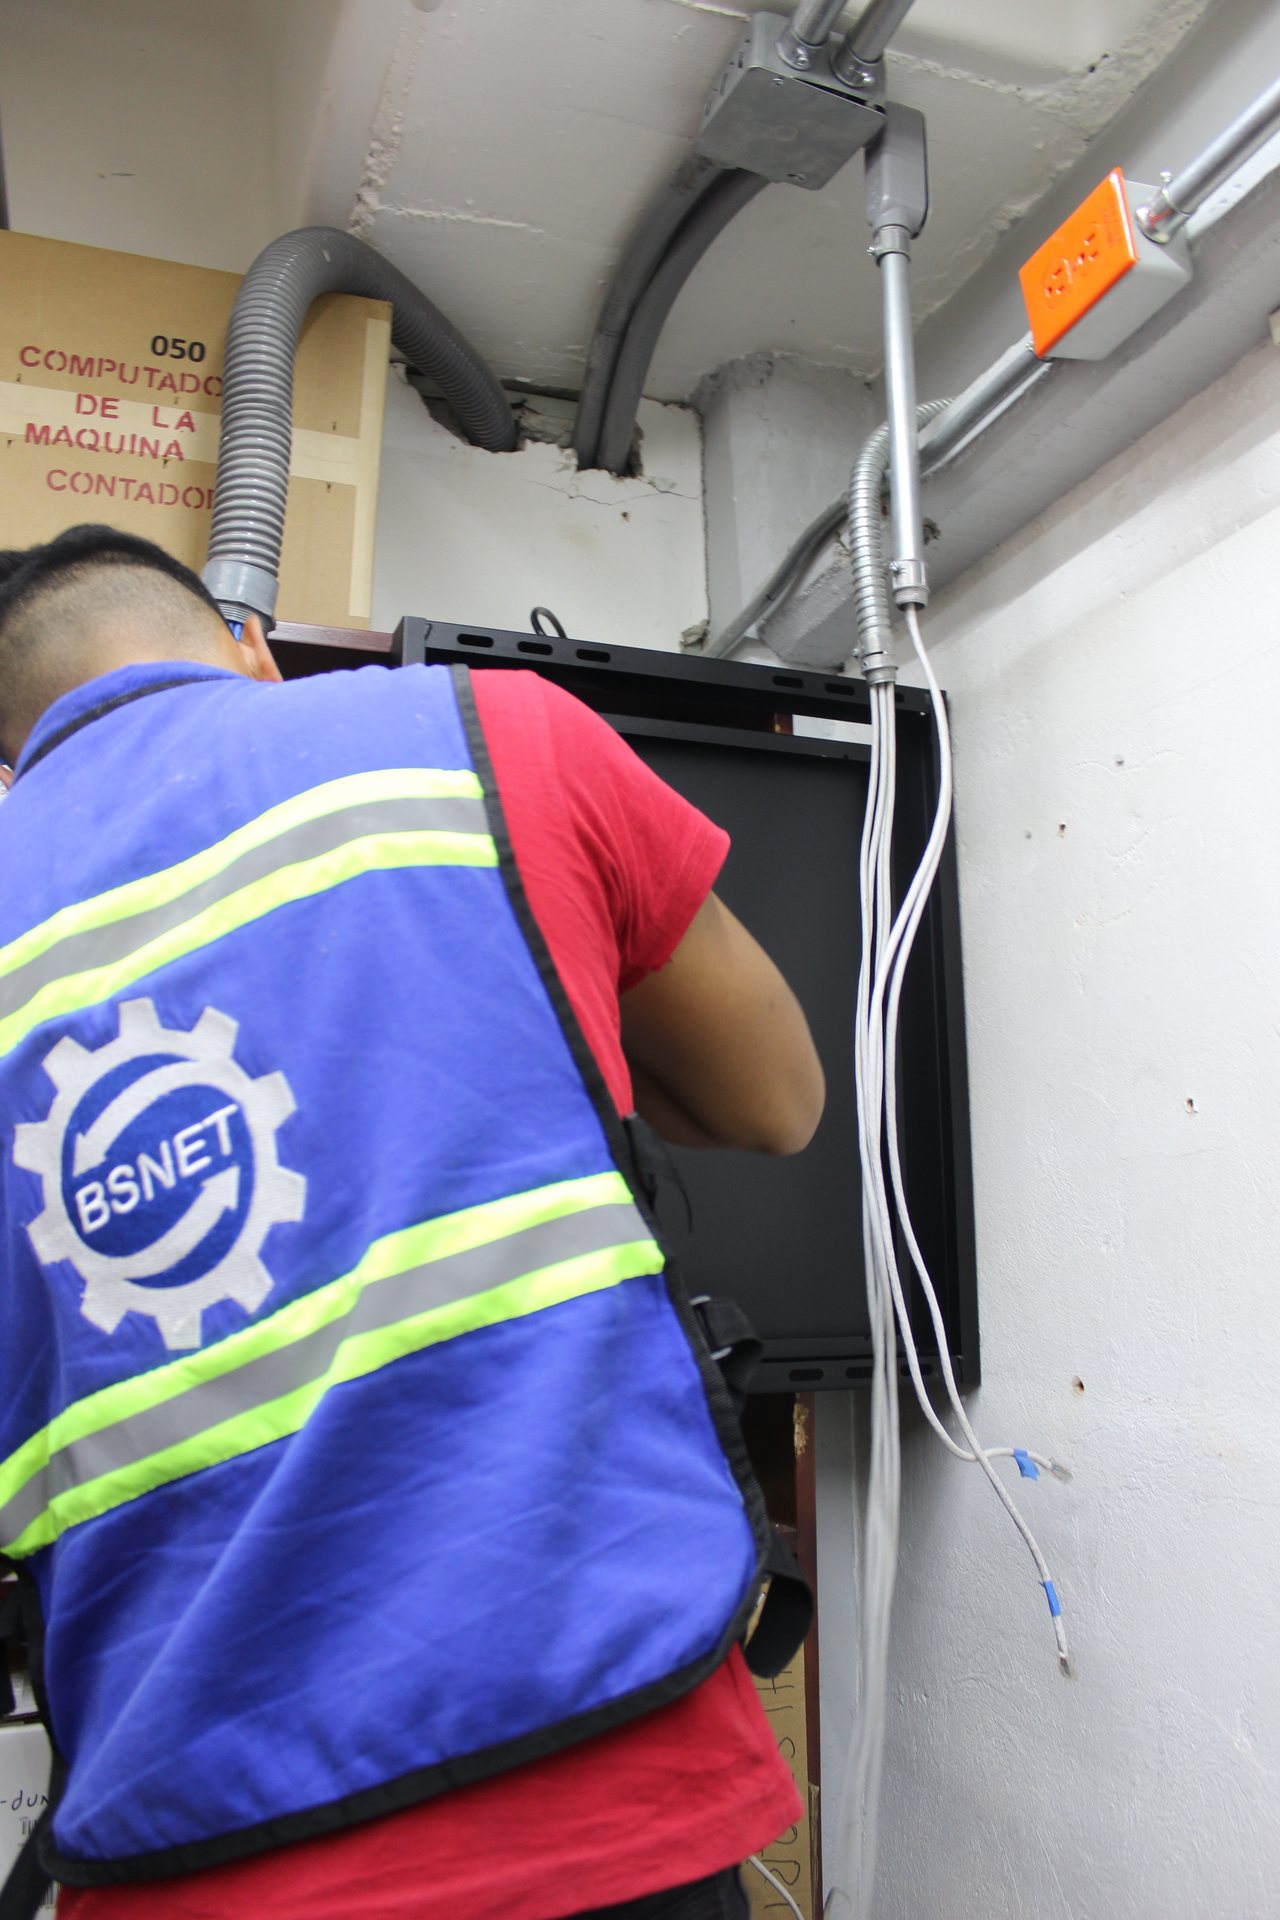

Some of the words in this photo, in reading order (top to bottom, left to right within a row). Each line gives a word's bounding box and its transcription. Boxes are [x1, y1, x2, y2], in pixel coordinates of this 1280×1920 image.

[151, 335, 206, 362] 050
[76, 393, 120, 419] DE
[152, 406, 196, 433] LA
[25, 422, 185, 461] MAQUINA
[76, 1104, 239, 1233] BSNET
